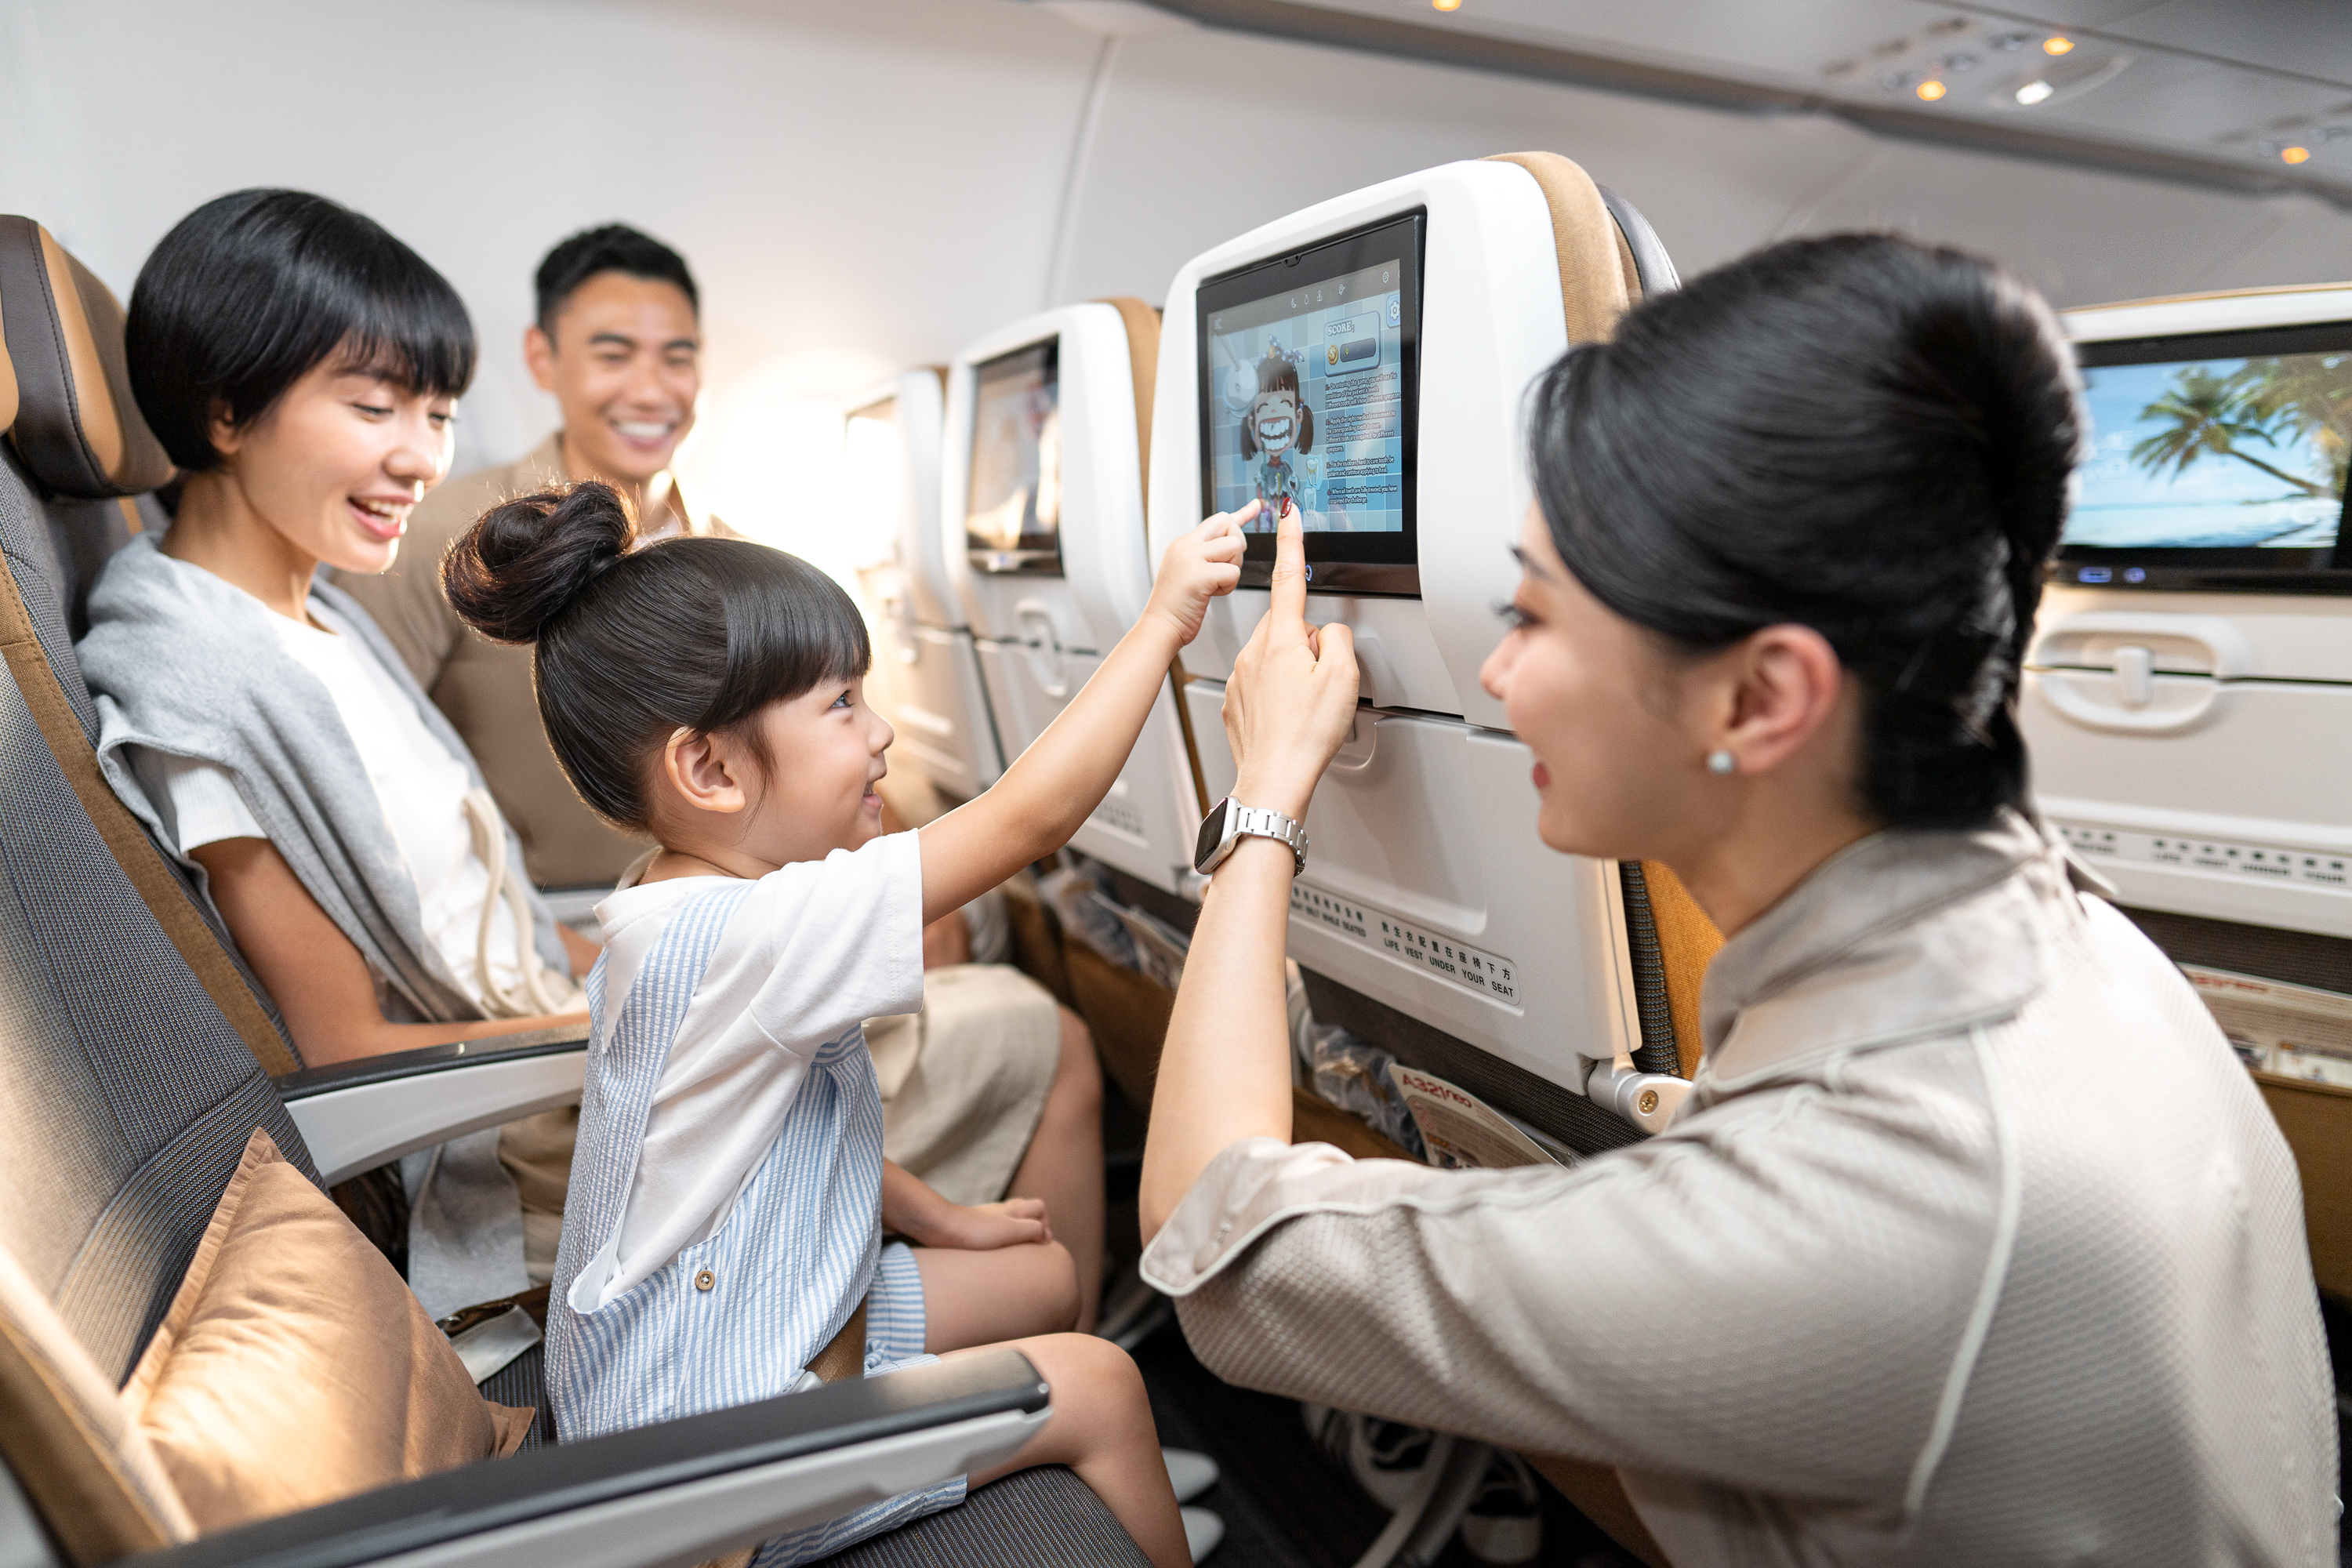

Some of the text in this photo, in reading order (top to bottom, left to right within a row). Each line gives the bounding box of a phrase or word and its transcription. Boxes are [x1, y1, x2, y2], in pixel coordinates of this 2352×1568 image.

[1326, 391, 1341, 400] condition
[1326, 401, 1341, 409] Different
[1347, 415, 1356, 423] right
[1356, 412, 1370, 422] medical
[1332, 425, 1356, 434] corresponding
[1356, 423, 1367, 431] tooth
[1356, 432, 1371, 441] required
[1378, 430, 1394, 438] different
[1360, 467, 1375, 476] applying
[1385, 938, 1513, 997] LIFE VEST UNDER YOUR SEAT
